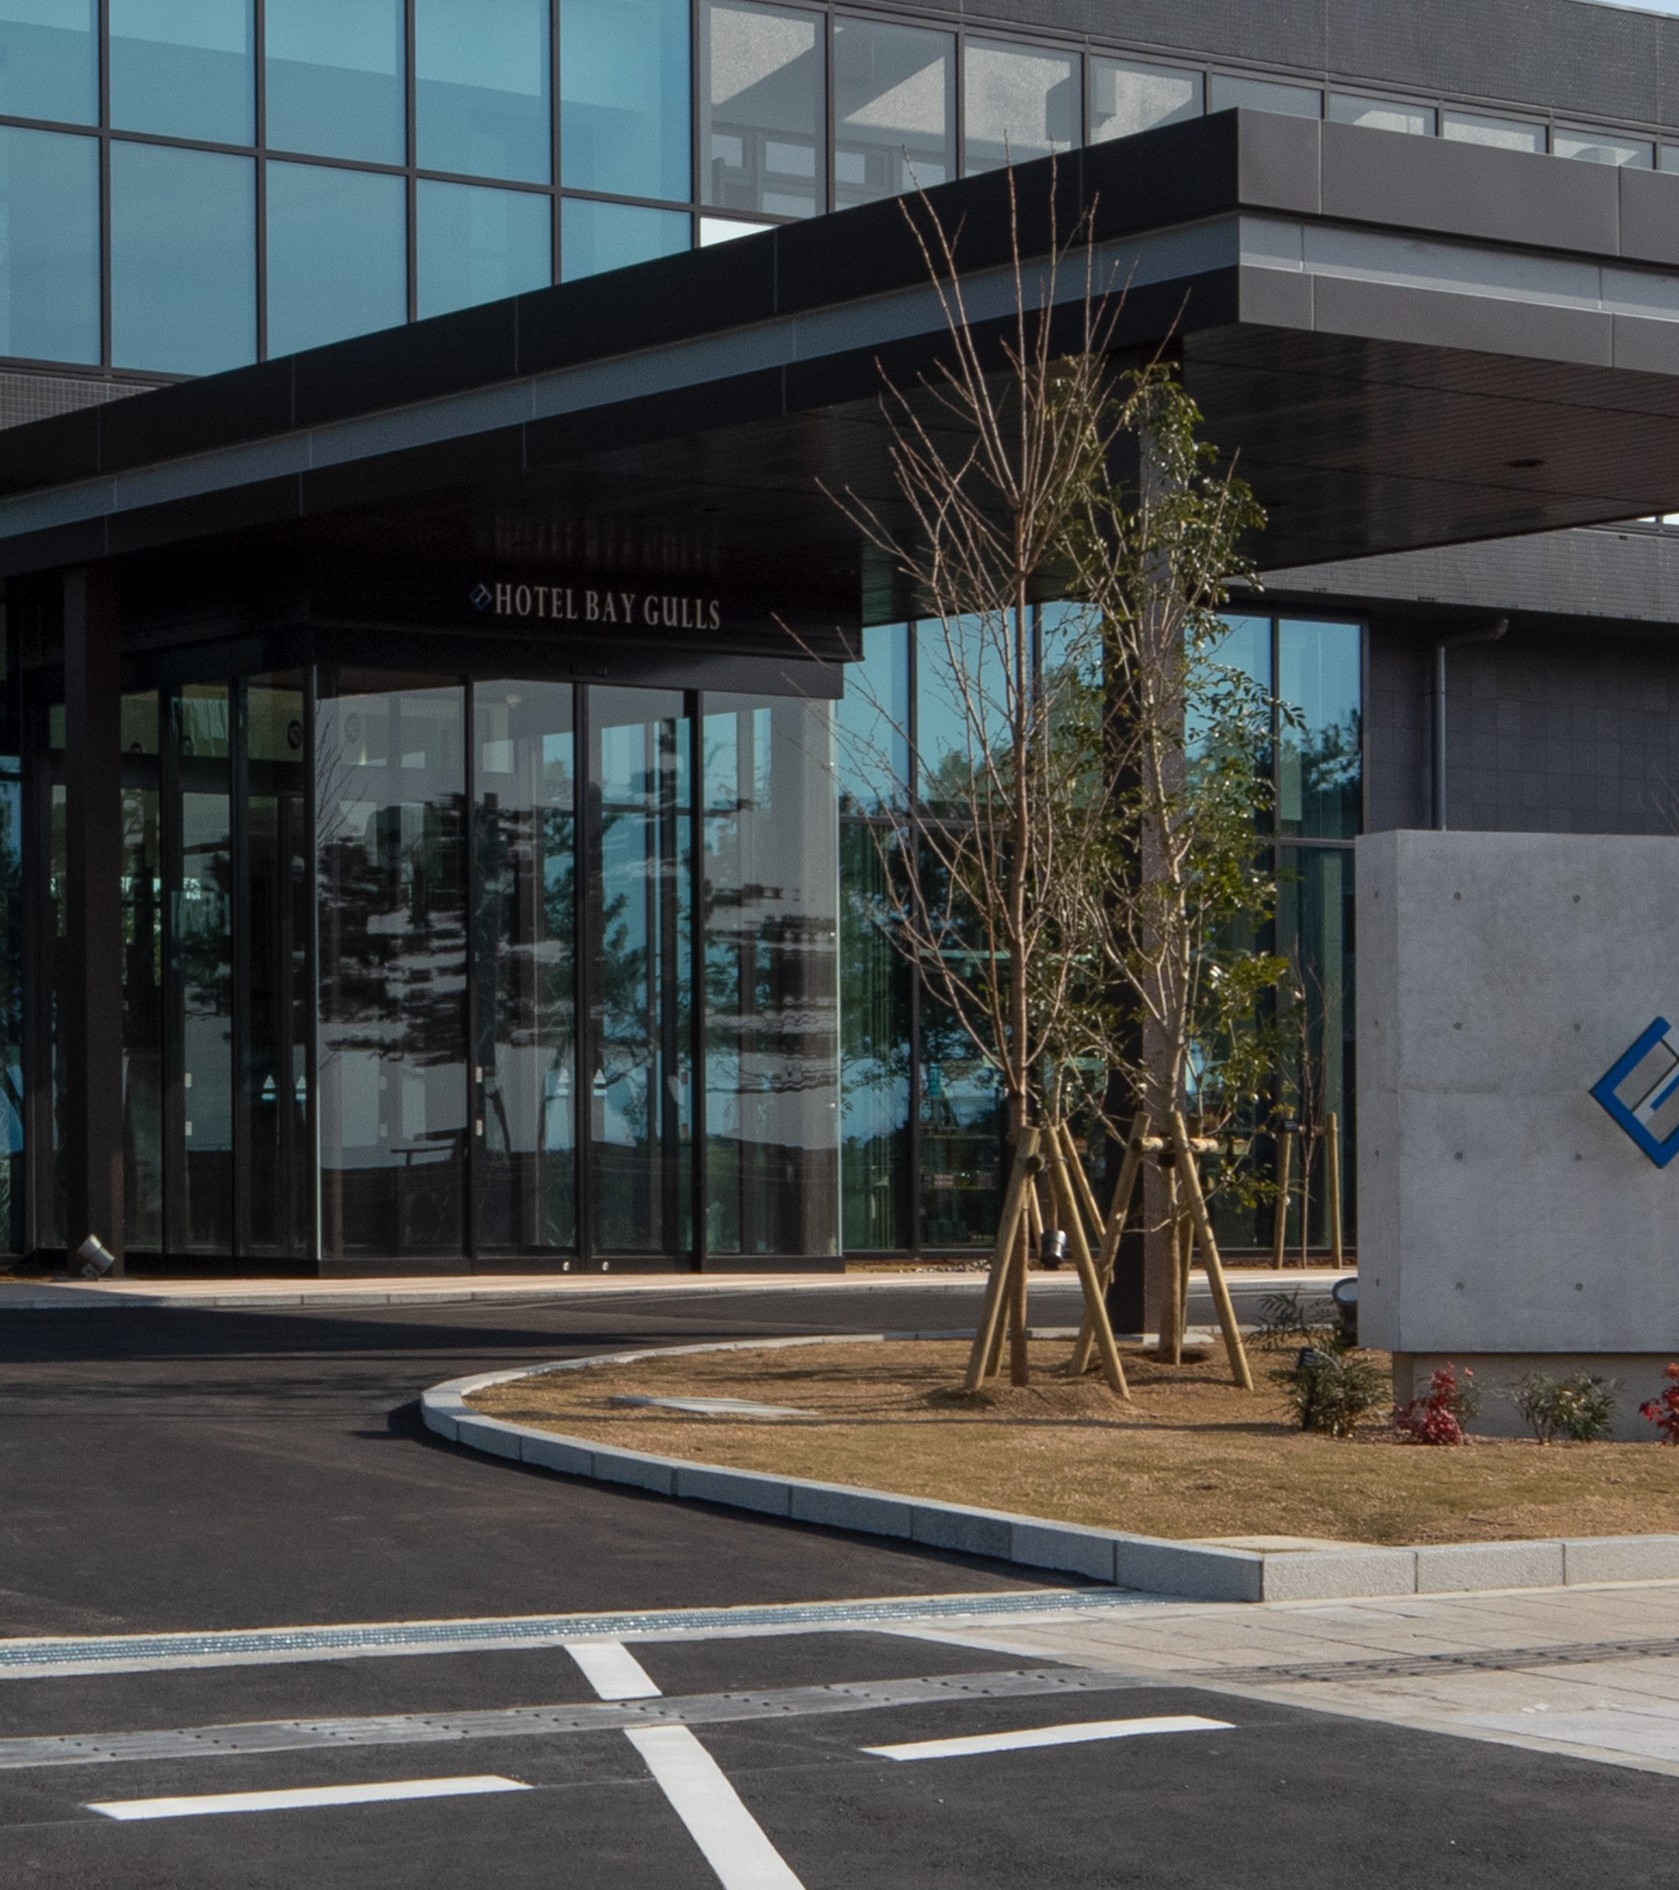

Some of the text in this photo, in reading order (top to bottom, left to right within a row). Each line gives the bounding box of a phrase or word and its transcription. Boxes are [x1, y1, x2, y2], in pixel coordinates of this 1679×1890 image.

[495, 583, 721, 630] HOTEL BAY GULLS
